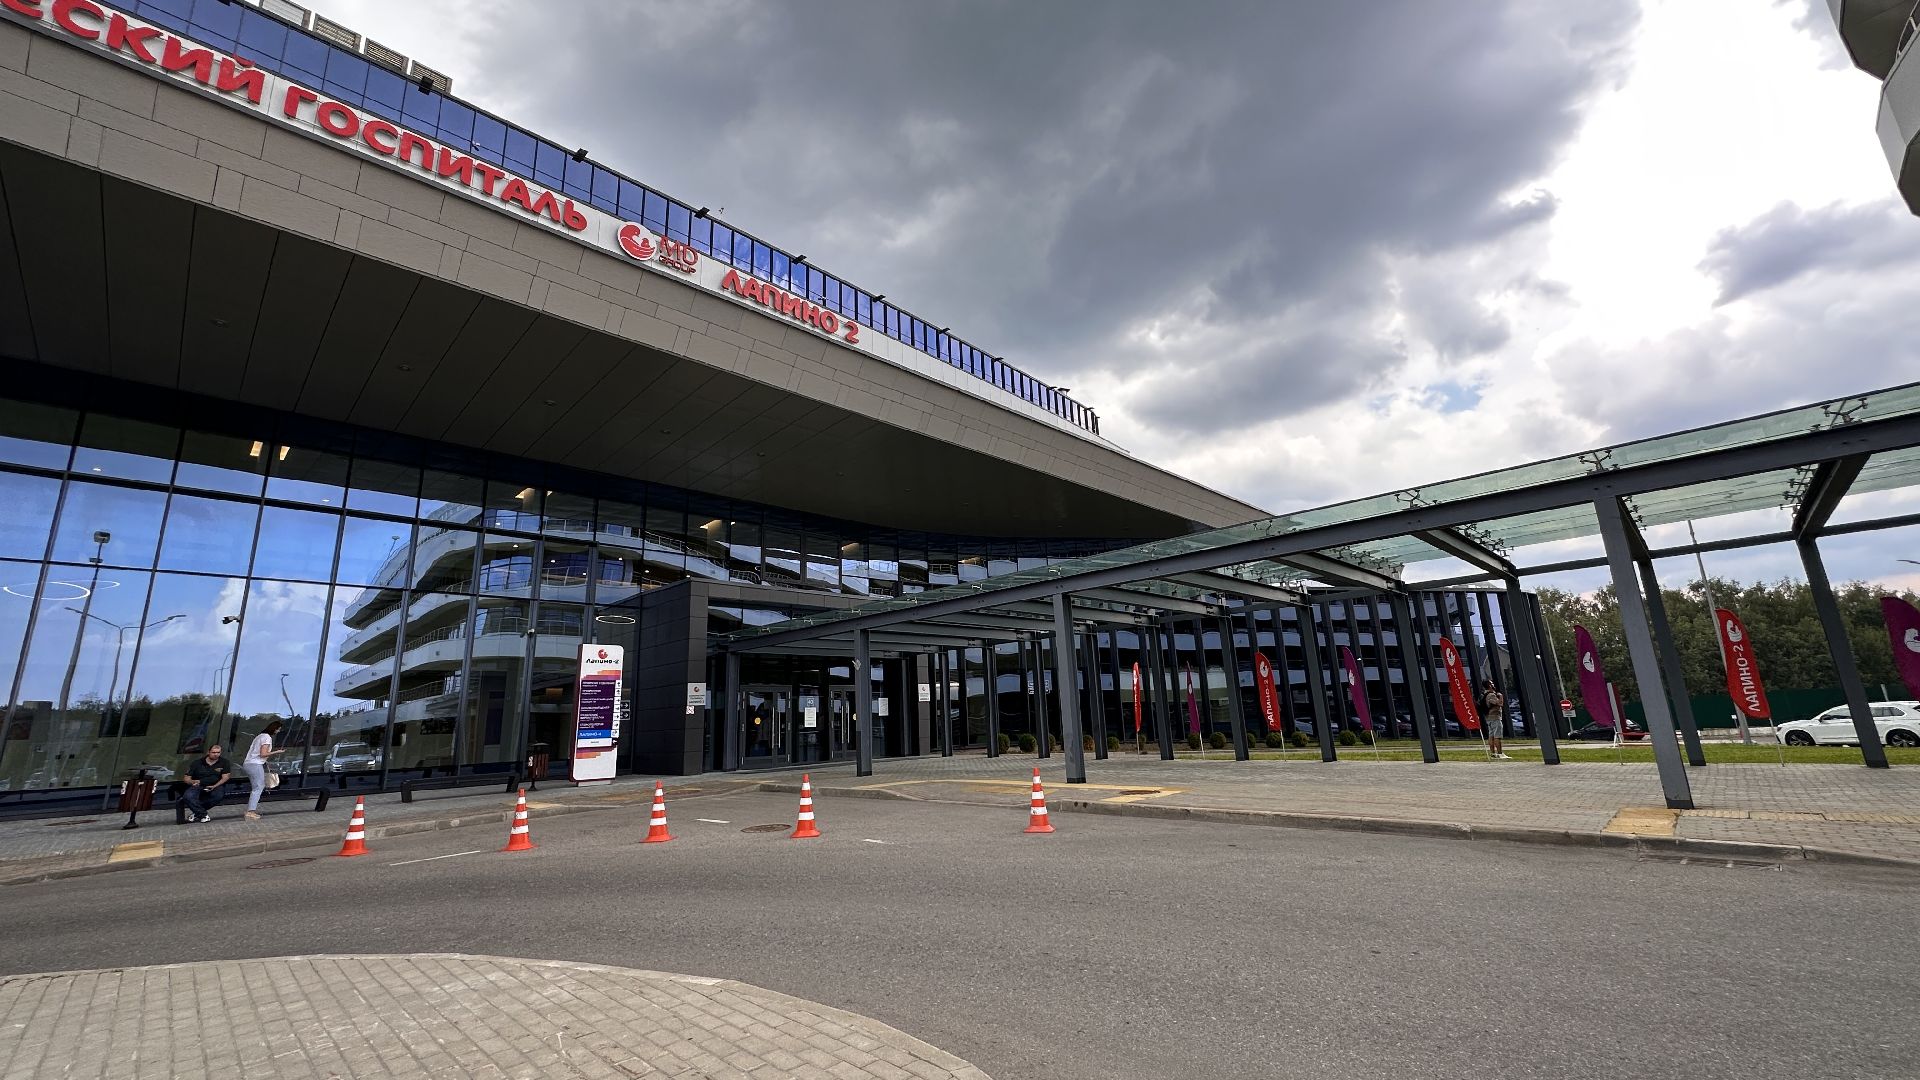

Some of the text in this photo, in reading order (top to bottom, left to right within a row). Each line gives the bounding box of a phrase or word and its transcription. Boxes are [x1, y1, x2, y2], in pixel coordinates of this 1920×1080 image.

[283, 85, 588, 232] ГОСПИТАЛЬ
[659, 255, 697, 274] GROUP
[660, 236, 699, 266] MD
[721, 269, 860, 344] ЛАПИНО 2
[1733, 644, 1761, 712] ЛАПИНО-2
